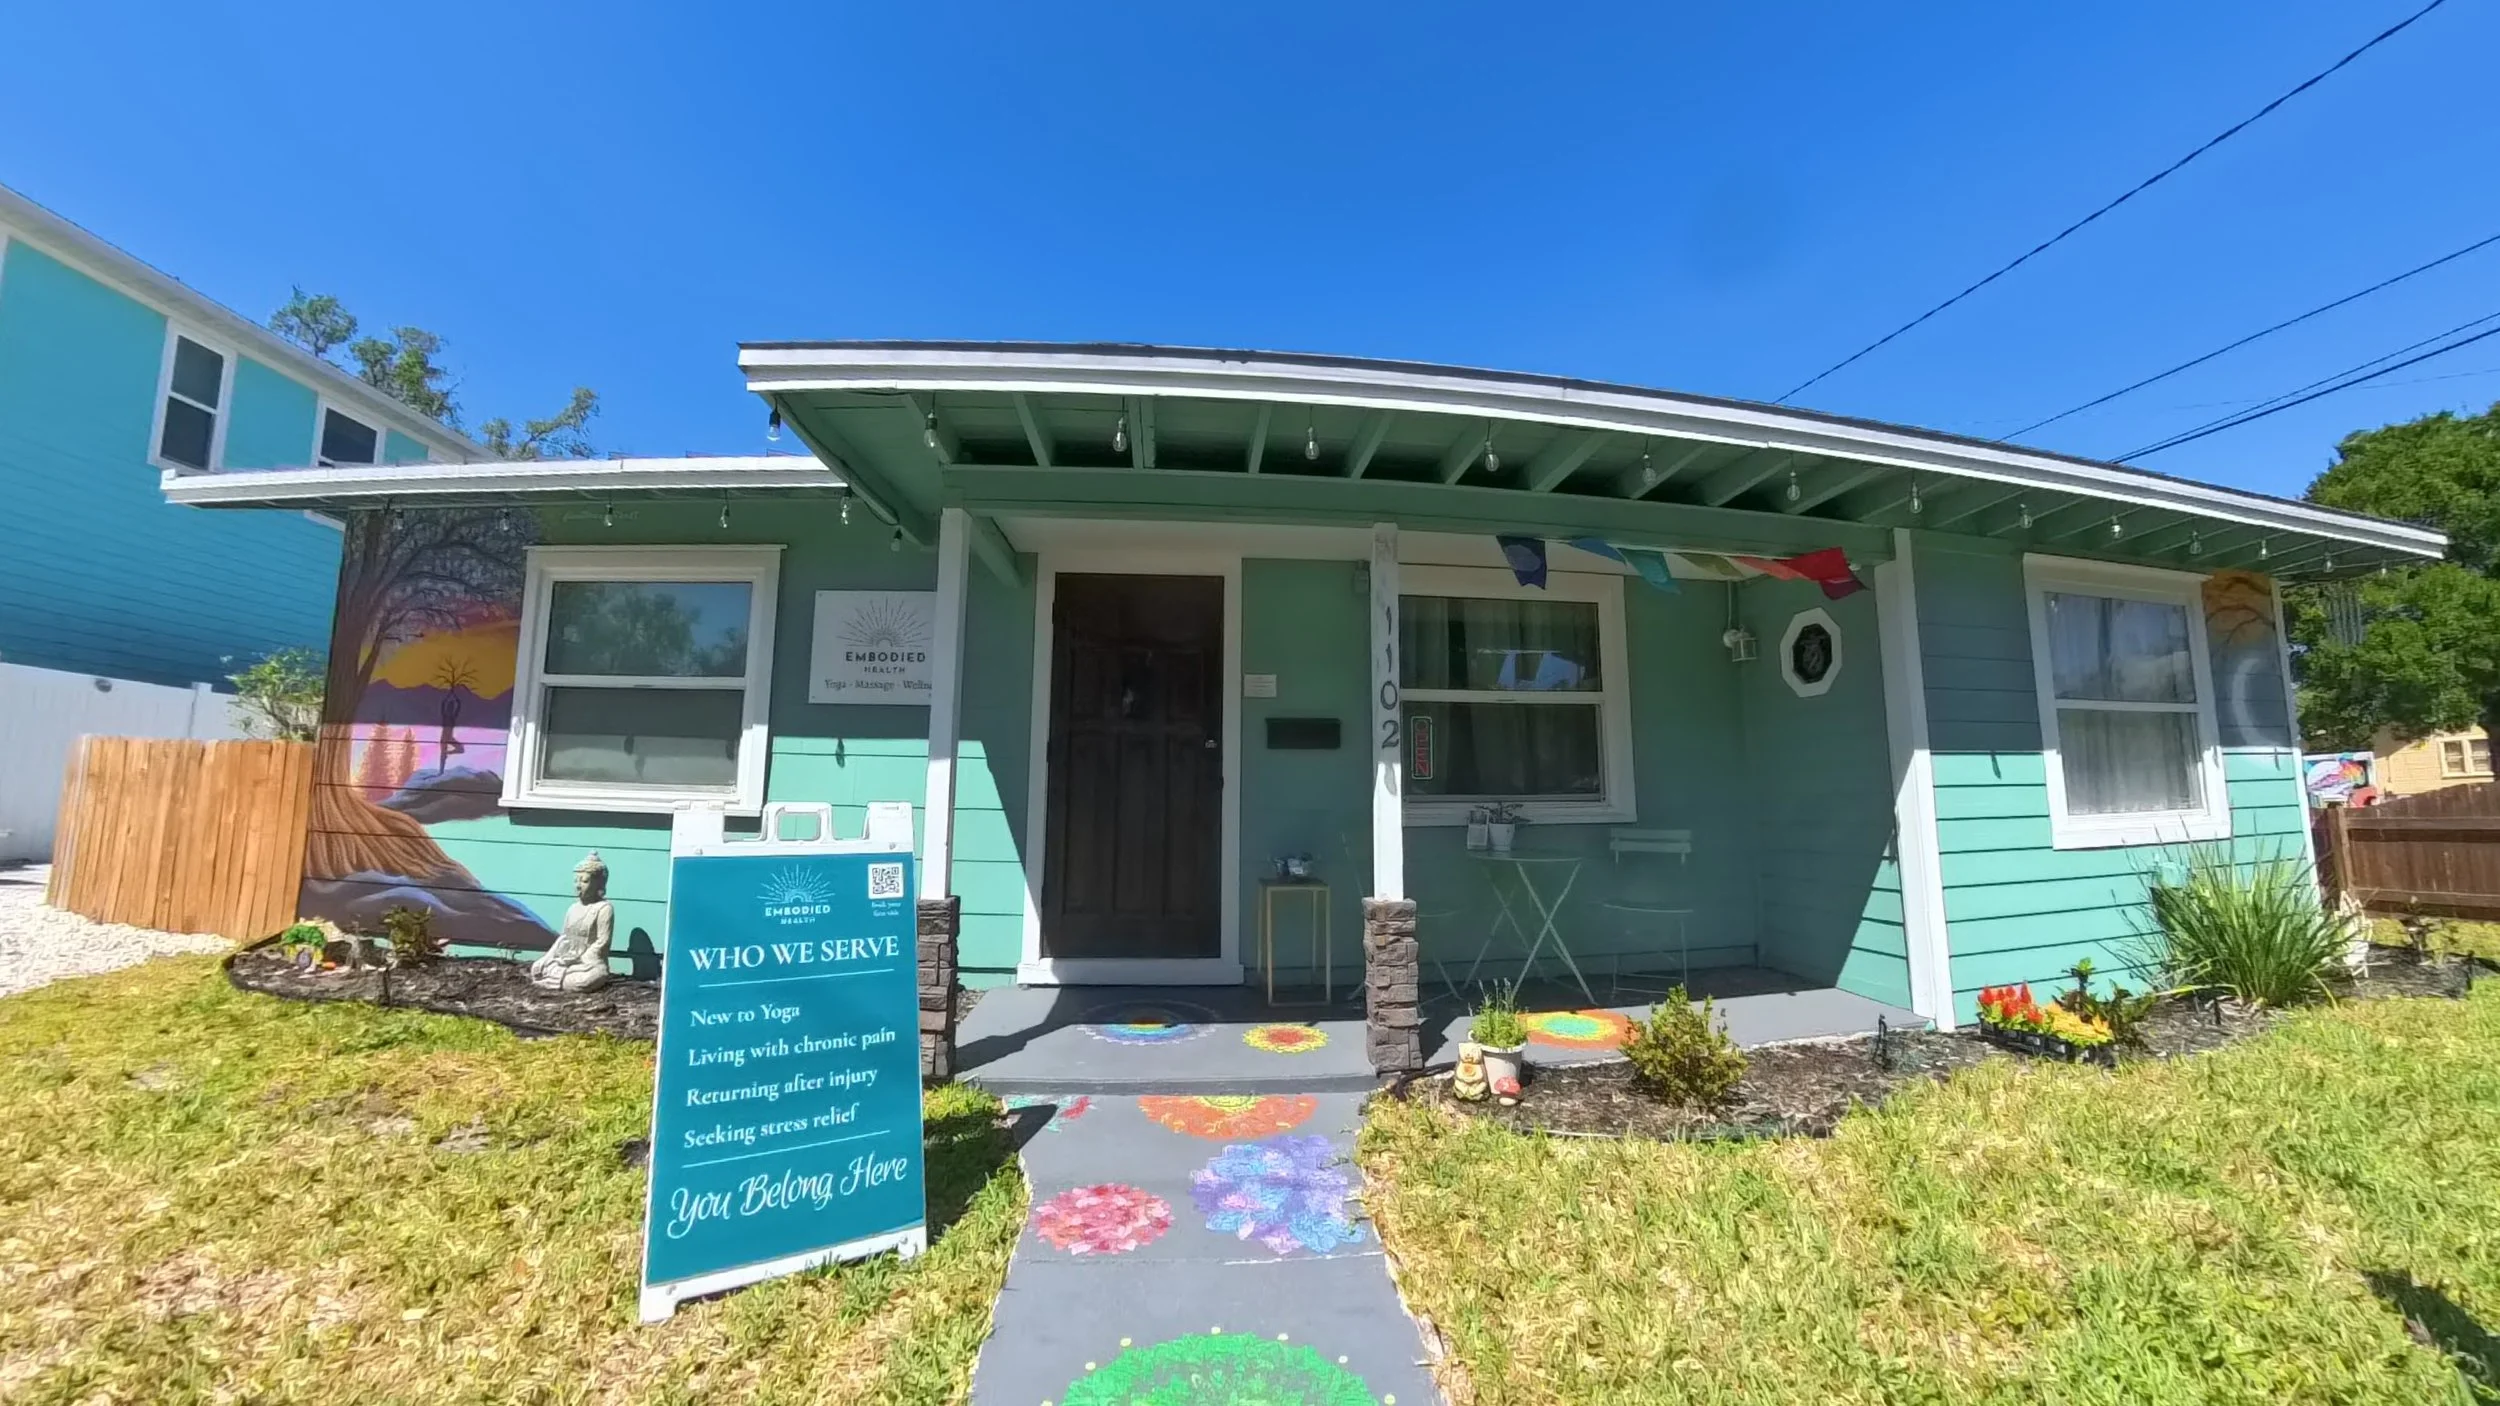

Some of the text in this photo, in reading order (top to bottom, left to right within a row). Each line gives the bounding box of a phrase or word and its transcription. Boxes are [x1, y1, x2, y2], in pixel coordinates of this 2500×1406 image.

[845, 651, 926, 663] EMBODIED
[864, 666, 906, 674] HEALTH
[825, 679, 847, 691] Yoga
[855, 680, 895, 692] Massage
[1380, 606, 1400, 749] 1102
[765, 905, 831, 917] EMBODIED
[780, 917, 816, 925] HEALTH
[689, 935, 900, 971] WHO WE SERVE
[690, 1003, 800, 1027] New to Yoga
[688, 1026, 896, 1068] Living with chronic pain
[686, 1068, 878, 1107] Returning after injury
[684, 1102, 860, 1148] Seeking stress relief
[667, 1150, 908, 1239] You Belong Here
